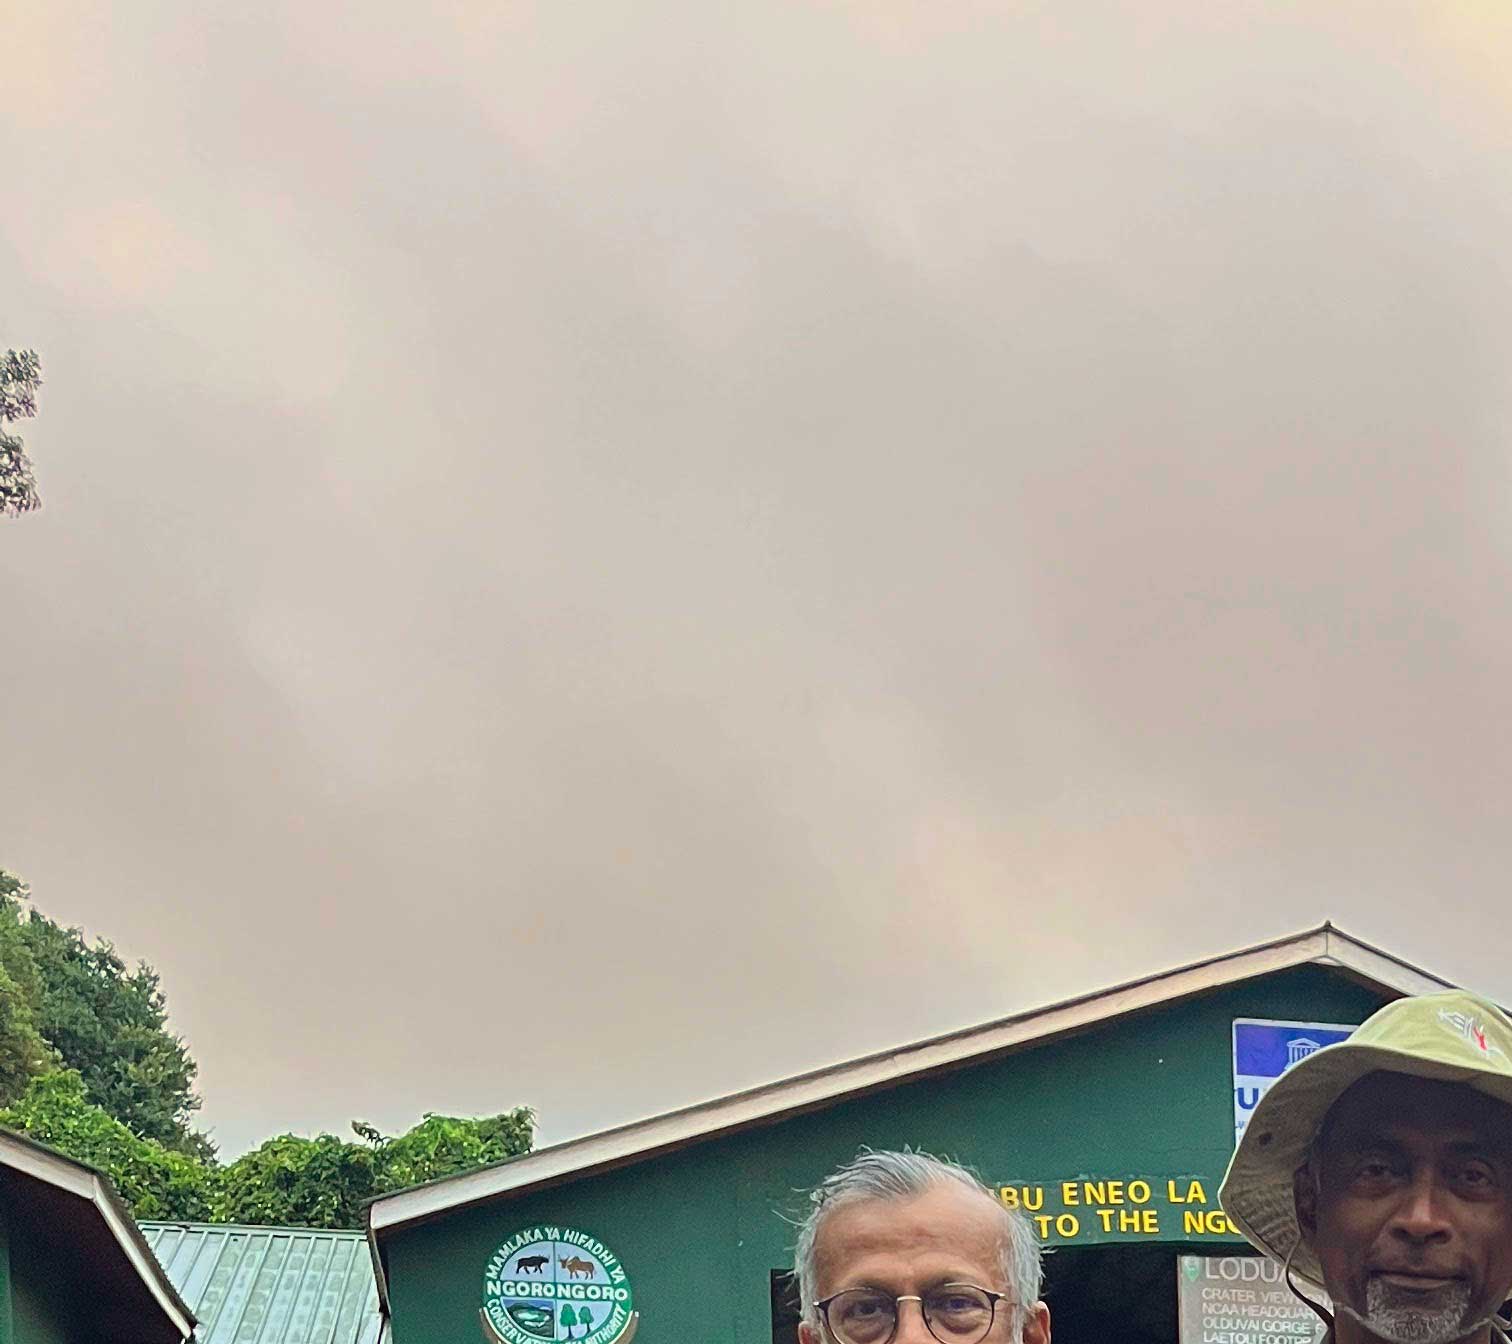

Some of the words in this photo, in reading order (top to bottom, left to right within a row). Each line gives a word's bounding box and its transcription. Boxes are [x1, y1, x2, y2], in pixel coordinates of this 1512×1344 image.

[1238, 1087, 1259, 1110] U
[1000, 1185, 1043, 1210] BU
[1062, 1180, 1151, 1206] ENEO
[1167, 1180, 1207, 1204] LA
[1034, 1214, 1080, 1238] TO
[1096, 1209, 1160, 1233] THE
[486, 1228, 543, 1279] MAMLAKA
[544, 1227, 561, 1240] YA
[563, 1228, 617, 1269] HIFADHI
[610, 1263, 626, 1284] YA
[487, 1280, 628, 1301] NGORONGORO
[1201, 1287, 1256, 1302] CRATER
[1201, 1303, 1241, 1315] NCAA
[1202, 1317, 1260, 1331] OLDUVAI
[1261, 1320, 1312, 1334] GORGE
[1203, 1331, 1257, 1344] LAETOLI
